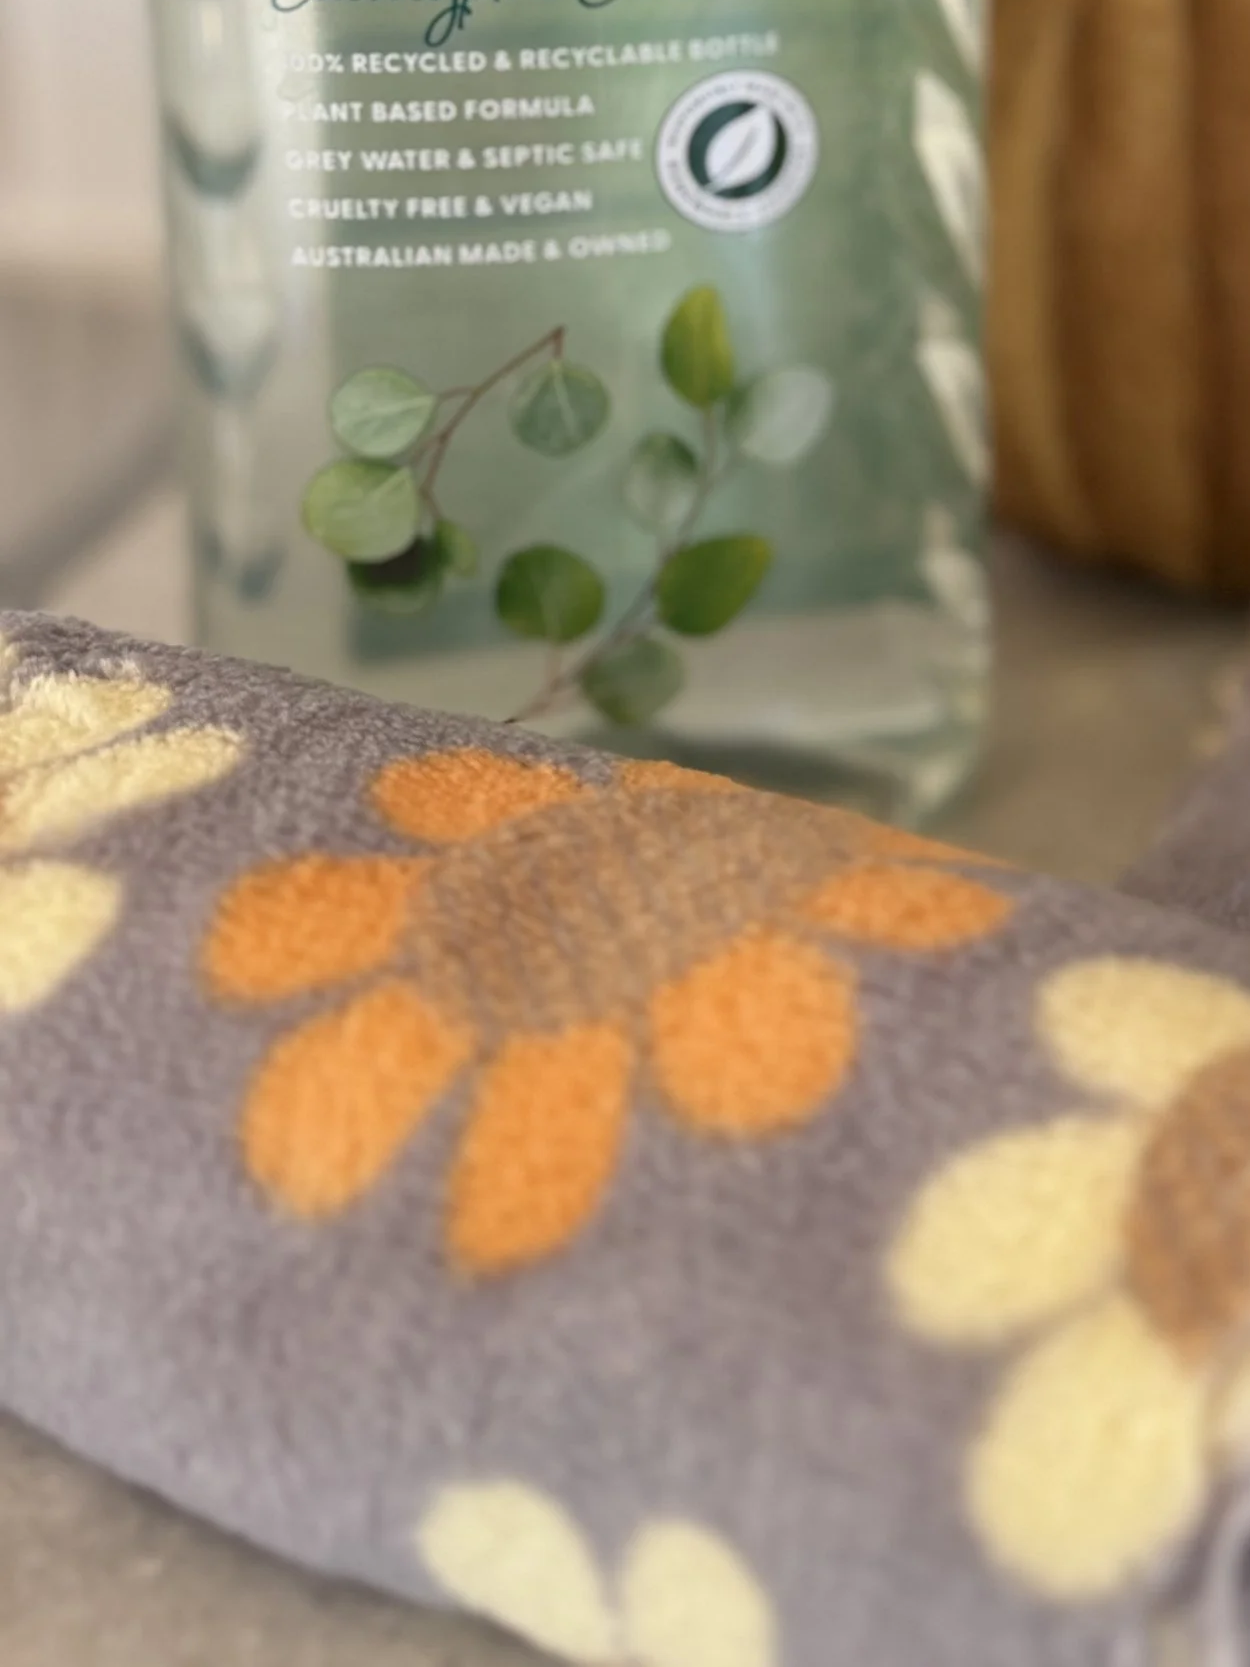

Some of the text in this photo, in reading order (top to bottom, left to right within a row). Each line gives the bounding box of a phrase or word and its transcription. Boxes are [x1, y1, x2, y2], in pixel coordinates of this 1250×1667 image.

[284, 52, 344, 75] 00%
[351, 50, 487, 74] RECYCLED
[493, 50, 513, 71] &
[519, 38, 683, 72] RECYCLABLE
[370, 99, 457, 123] BASED
[463, 94, 596, 121] FORMULA
[284, 137, 645, 172] GREY WATER & SEPTIC SAFE
[287, 189, 593, 221] CRUELTY FREE & VEGAN
[290, 242, 454, 269] AUSTRALIAN
[458, 238, 538, 267] MADE
[543, 237, 563, 262] &
